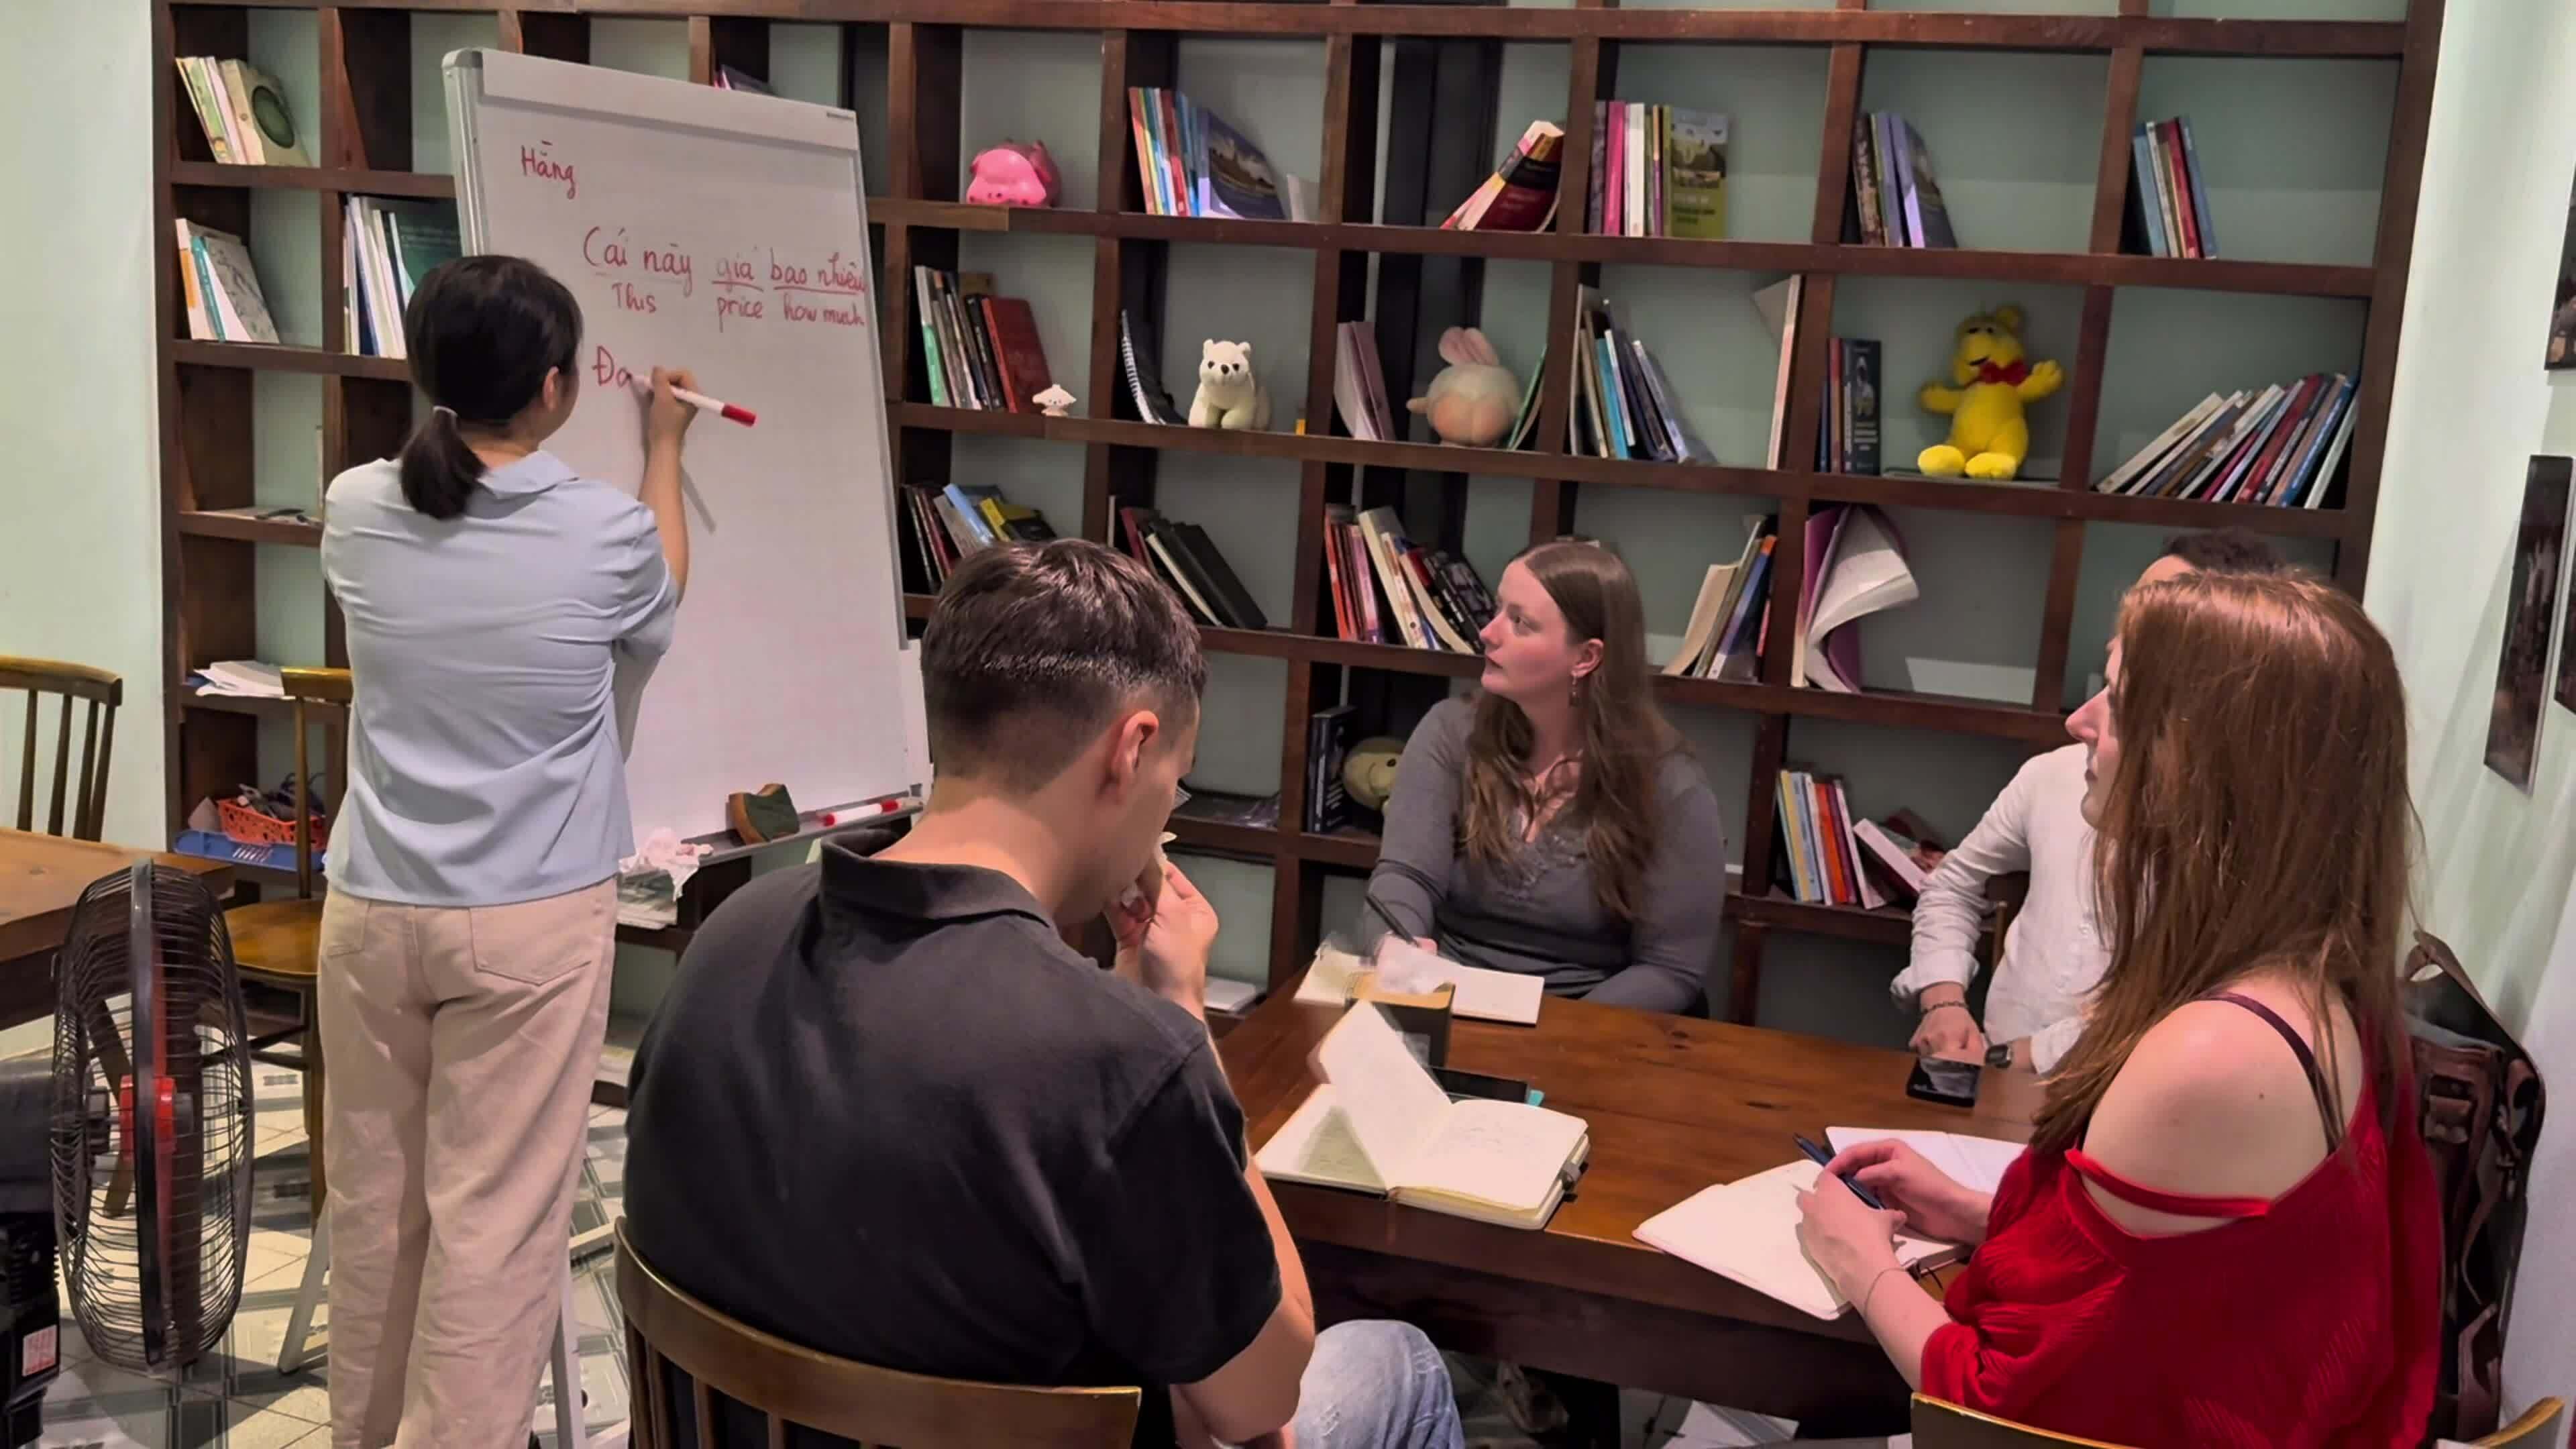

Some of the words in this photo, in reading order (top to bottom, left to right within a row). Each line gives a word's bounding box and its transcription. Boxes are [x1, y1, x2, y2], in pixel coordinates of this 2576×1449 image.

[584, 226, 627, 266] Cái
[643, 242, 692, 298] này
[716, 246, 757, 292] giá
[770, 247, 807, 284] bao
[612, 282, 657, 313] This
[717, 297, 763, 333] price
[784, 292, 816, 321] how
[823, 302, 865, 326] much
